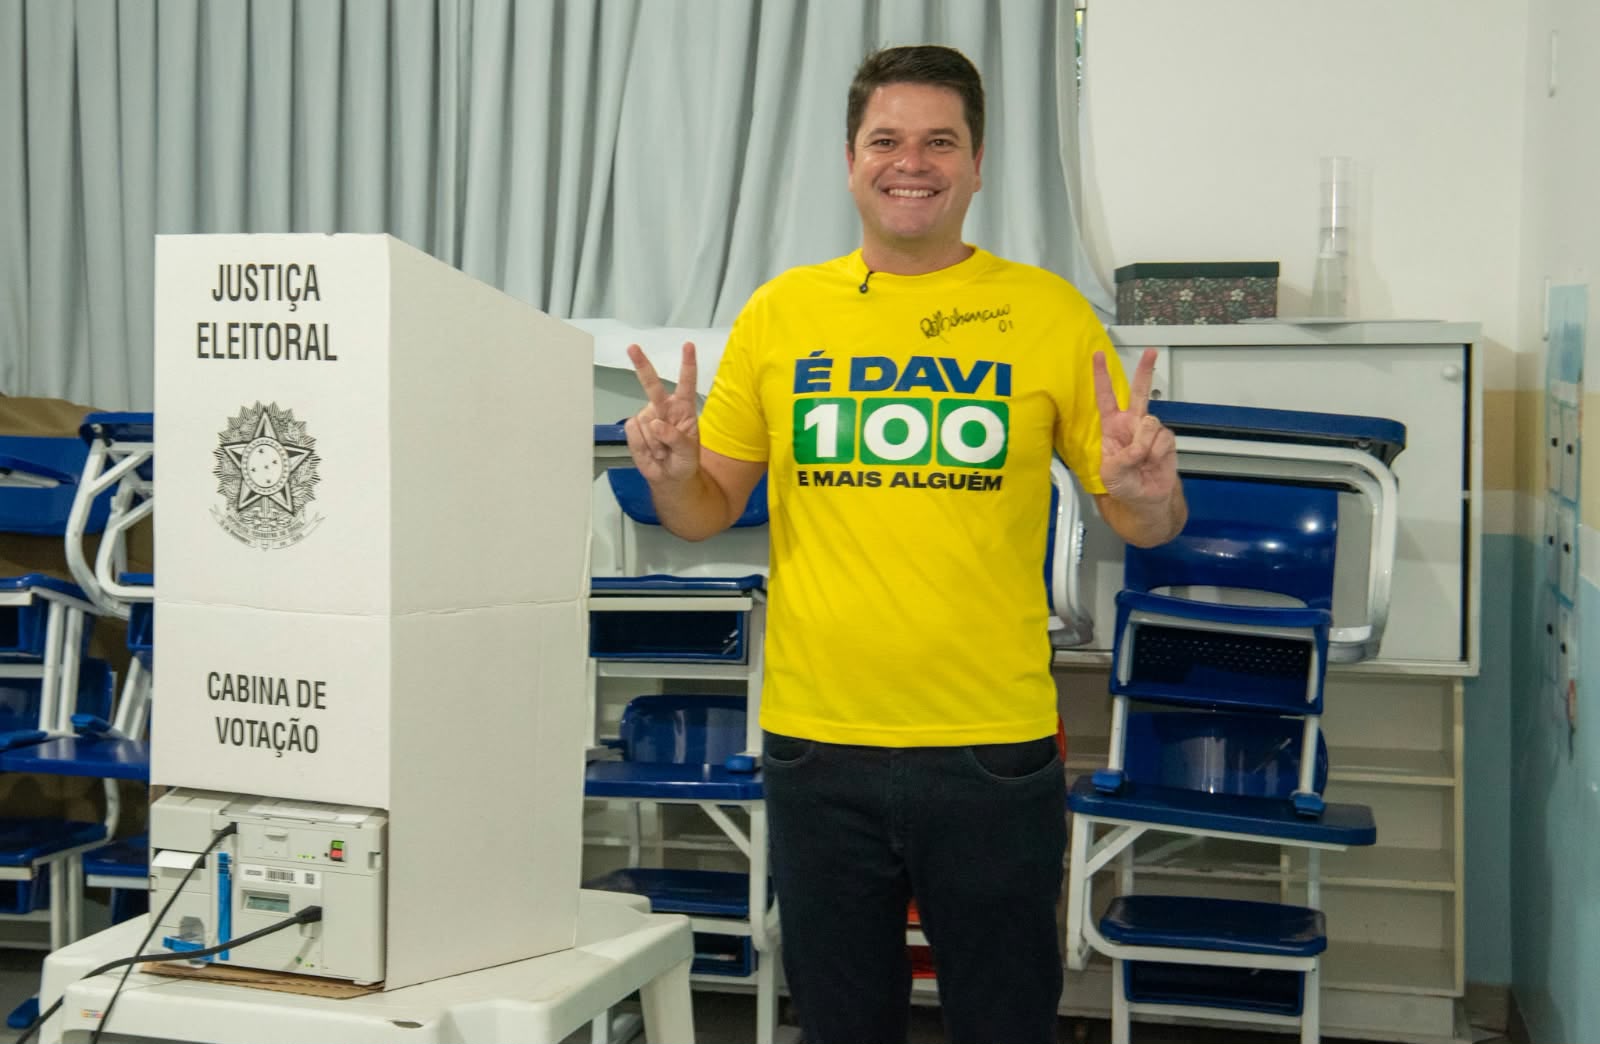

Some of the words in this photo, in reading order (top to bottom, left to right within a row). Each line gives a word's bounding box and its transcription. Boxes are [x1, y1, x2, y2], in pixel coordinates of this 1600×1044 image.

[212, 263, 321, 312] JUSTIÇA
[197, 322, 338, 361] ELEITORAL
[793, 350, 833, 394] É
[848, 356, 1012, 397] DAVI
[804, 403, 1005, 463] 100
[797, 470, 809, 487] E
[813, 470, 882, 487] MAIS
[889, 470, 1003, 491] ALGUÉM
[207, 671, 291, 707] CABINA
[296, 679, 327, 709] DE
[215, 717, 319, 757] VOTAÇÃO
